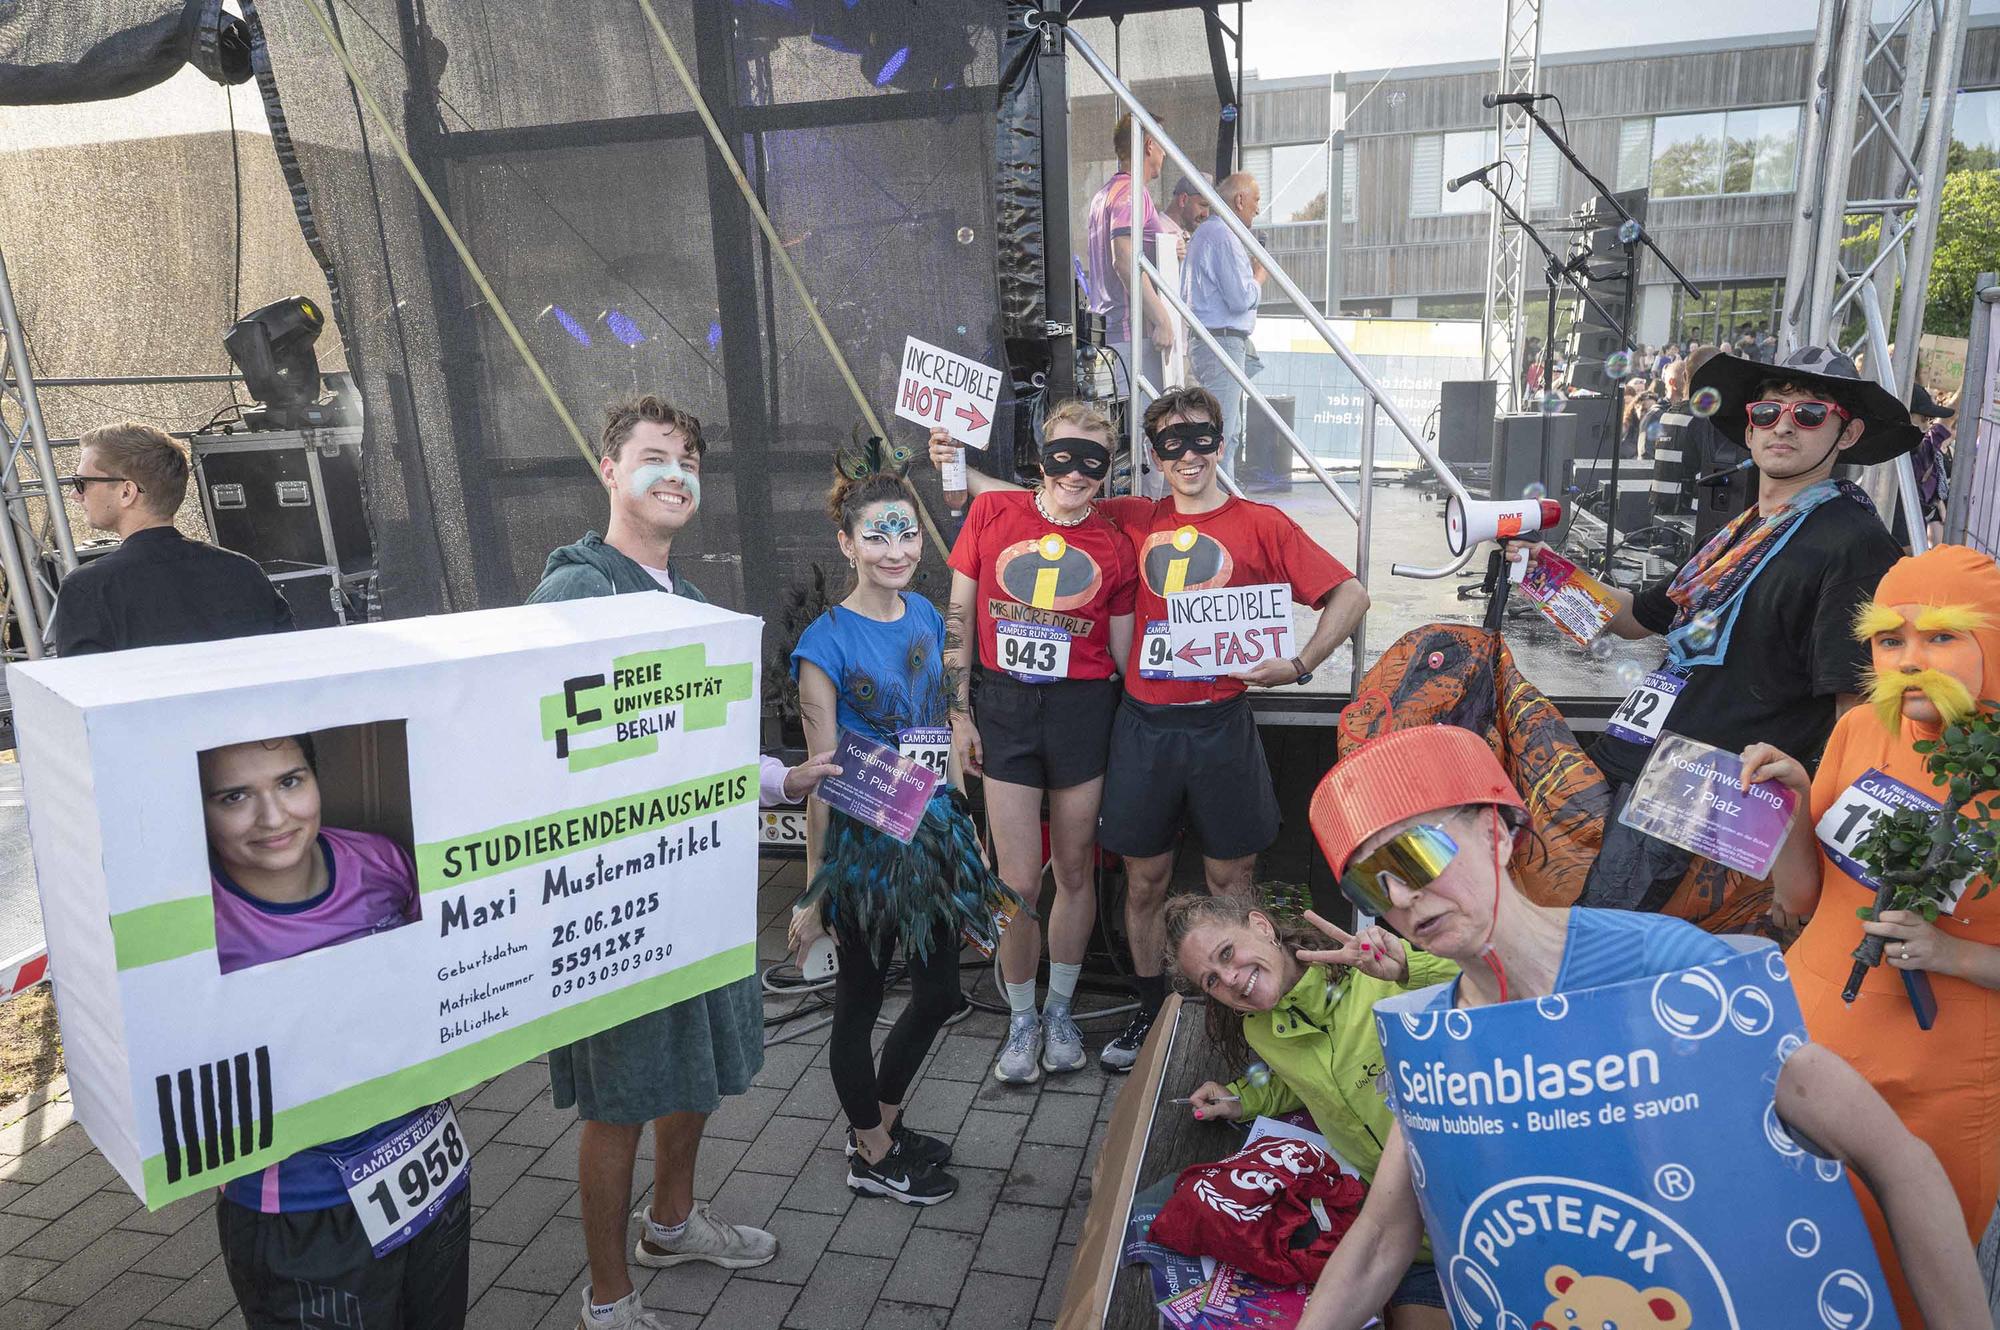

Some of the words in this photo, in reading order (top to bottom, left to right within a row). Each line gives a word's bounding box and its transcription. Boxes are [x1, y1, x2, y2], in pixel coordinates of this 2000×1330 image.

[907, 346, 998, 402] INCREDIBLE
[902, 378, 952, 422] HOT
[1011, 605, 1091, 634] INCREDIBLE
[1172, 589, 1285, 624] INCREDIBLE
[998, 625, 1027, 637] CAMPUS
[1029, 630, 1047, 639] RUN
[1049, 632, 1067, 641] 2025
[1215, 626, 1287, 667] FAST
[1005, 638, 1057, 672] 943
[614, 663, 662, 691] FREIE
[614, 677, 722, 714] UNIVERSITÄT
[1658, 680, 1677, 693] 2025
[617, 710, 676, 742] BERLIN
[902, 734, 936, 743] CAMPUS
[936, 735, 951, 743] RUN
[847, 743, 925, 791] Kostümwertung
[857, 769, 867, 782] 5.
[870, 775, 897, 797] Platz
[1667, 752, 1784, 809] Kostümwetung
[1682, 784, 1695, 800] 7.
[1700, 791, 1742, 817] Platz
[442, 775, 746, 877] STUDIERENDENAUSWEIS
[441, 888, 516, 937] Maxi
[542, 820, 720, 905] Mustermatrikel
[437, 943, 528, 981] Geburtsdatum
[552, 892, 659, 947] 26.06.2025
[440, 1007, 509, 1043] Bibliothek
[552, 944, 672, 997] 03030303030
[440, 972, 534, 1016] Matrikelnummer
[1400, 1048, 1660, 1106] Seifenblasen
[1443, 1116, 1504, 1135] bubbles
[1527, 1109, 1591, 1132] Bulles
[1598, 1103, 1625, 1125] de
[1633, 1092, 1699, 1120] savon
[352, 1138, 411, 1182] CAMPUS
[412, 1117, 435, 1143] RUN
[373, 1142, 392, 1157] FREIE
[368, 1122, 463, 1226] 1958
[1474, 1195, 1672, 1273] PUSTEFIX
